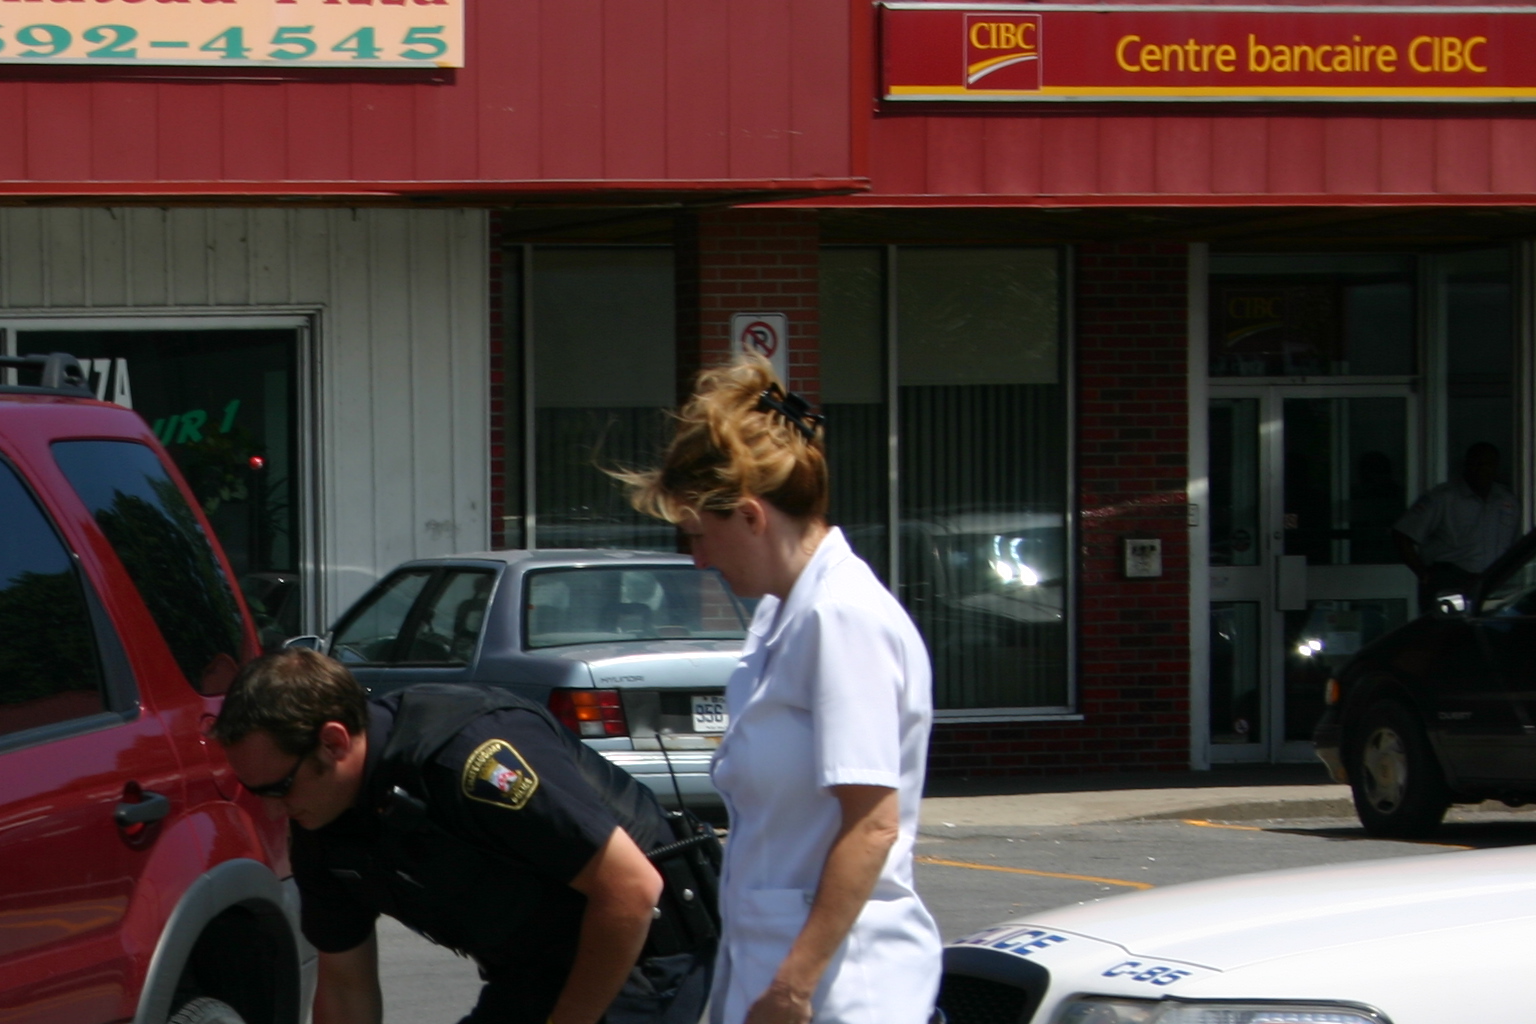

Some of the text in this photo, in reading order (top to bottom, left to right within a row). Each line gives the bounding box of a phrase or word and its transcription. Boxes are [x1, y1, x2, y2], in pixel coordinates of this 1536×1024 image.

[970, 22, 1037, 50] CIBC
[1116, 34, 1488, 73] Centre bancaire CIBC
[1102, 961, 1193, 986] C-85
